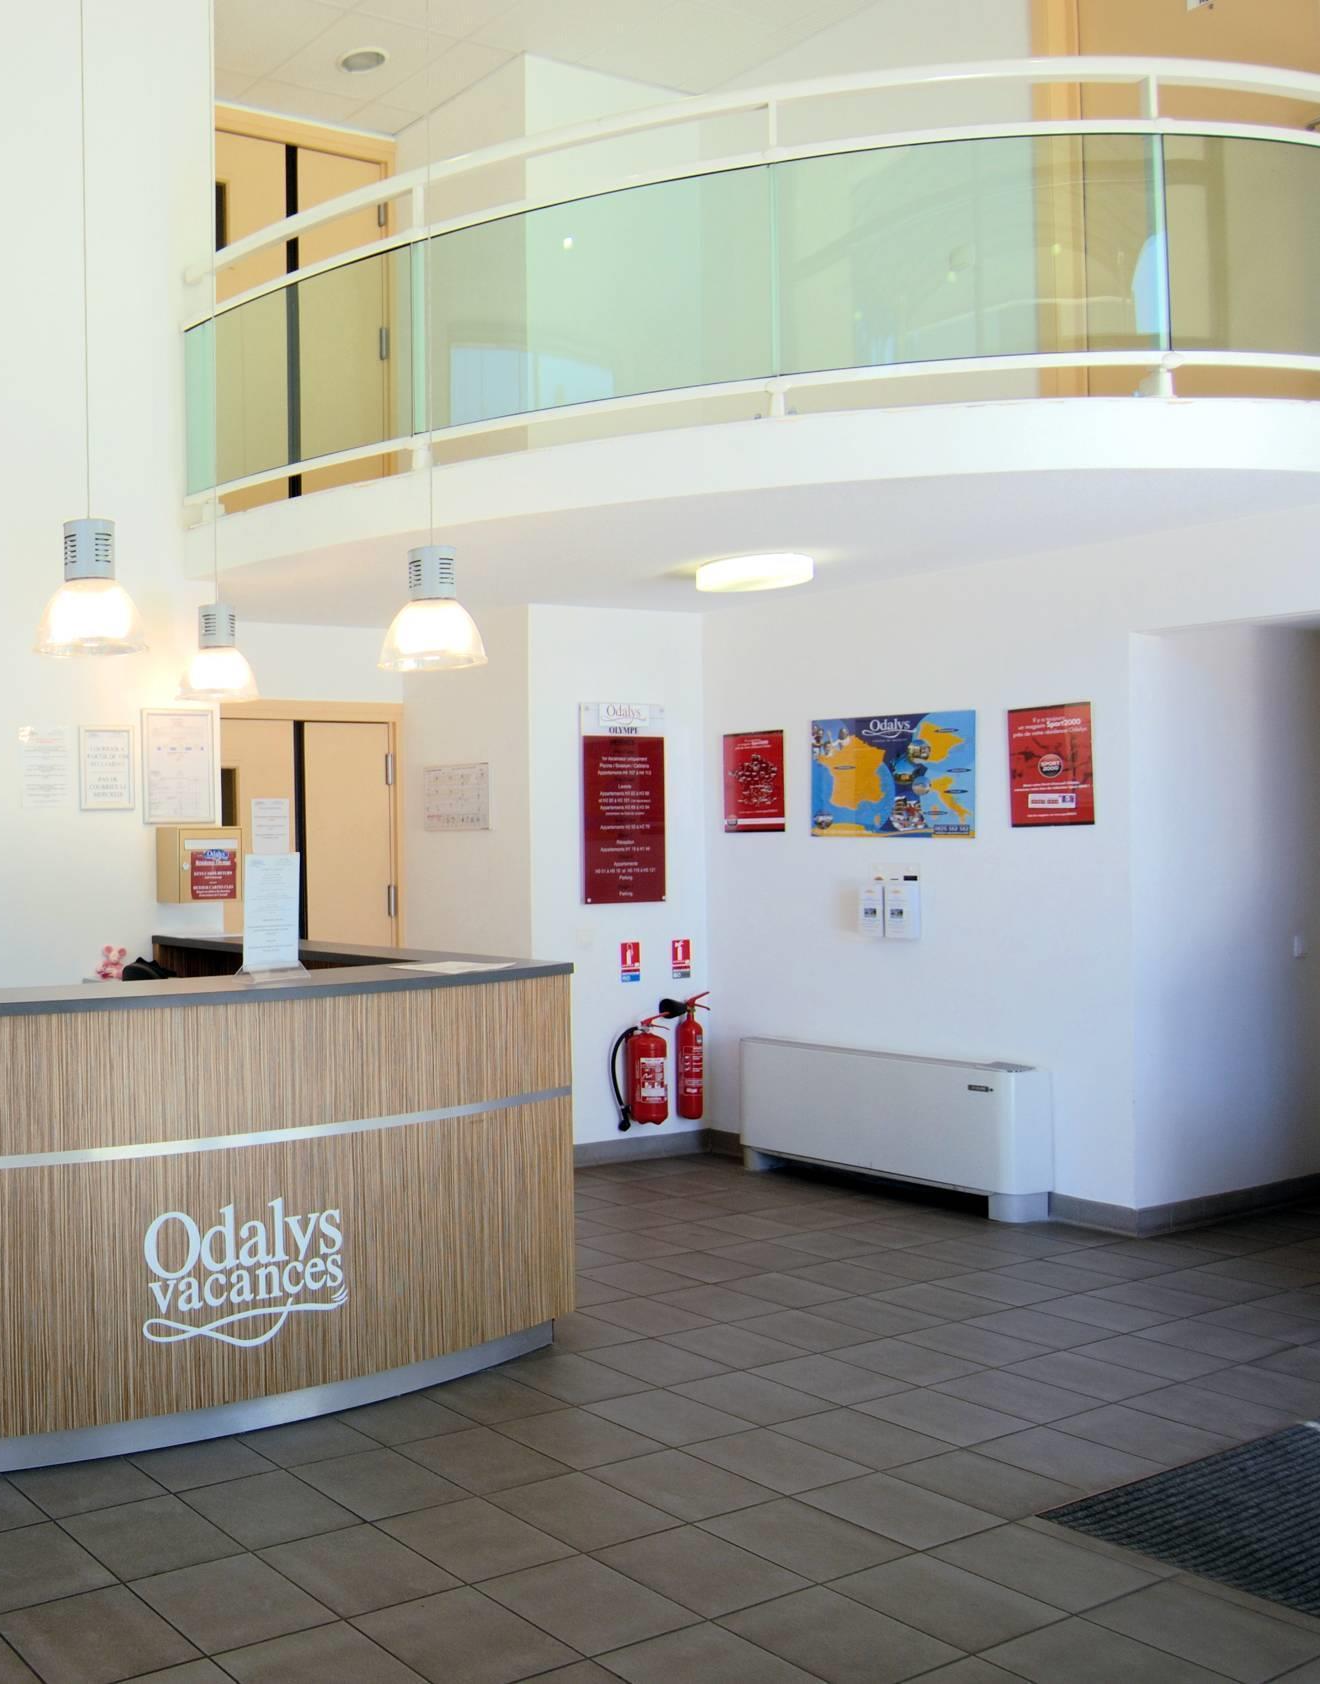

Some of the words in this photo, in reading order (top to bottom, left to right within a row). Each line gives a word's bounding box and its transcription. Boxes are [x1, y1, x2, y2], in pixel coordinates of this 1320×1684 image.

[869, 718, 911, 735] Odalys
[144, 1196, 344, 1280] Odalys
[148, 1254, 344, 1314] vacances
